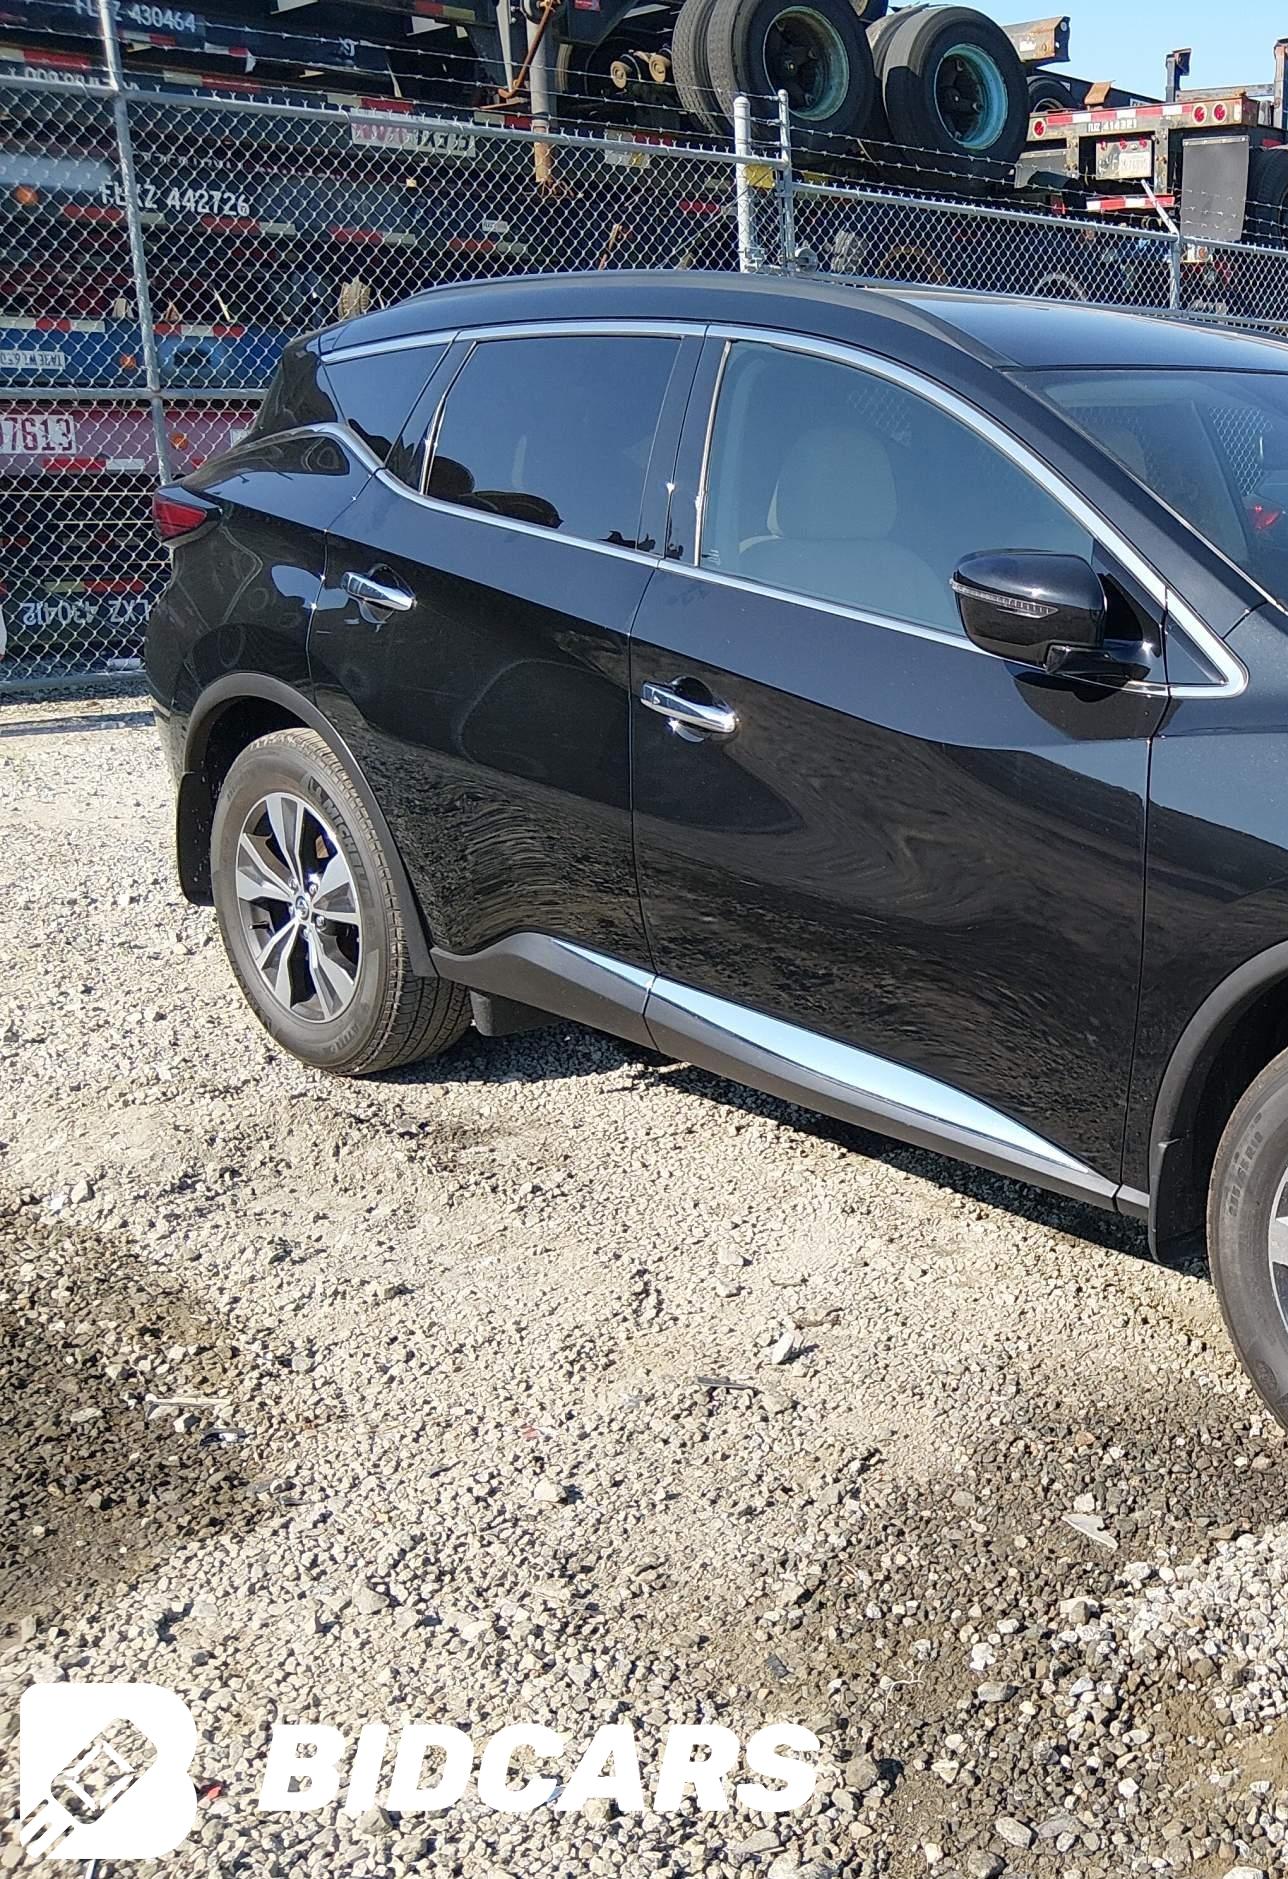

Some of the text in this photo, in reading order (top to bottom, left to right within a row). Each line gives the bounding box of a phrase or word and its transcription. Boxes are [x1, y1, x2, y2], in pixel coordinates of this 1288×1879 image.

[74, 0, 196, 32] FLZ 430464
[166, 186, 250, 216] 442726
[0, 416, 73, 452] 7613
